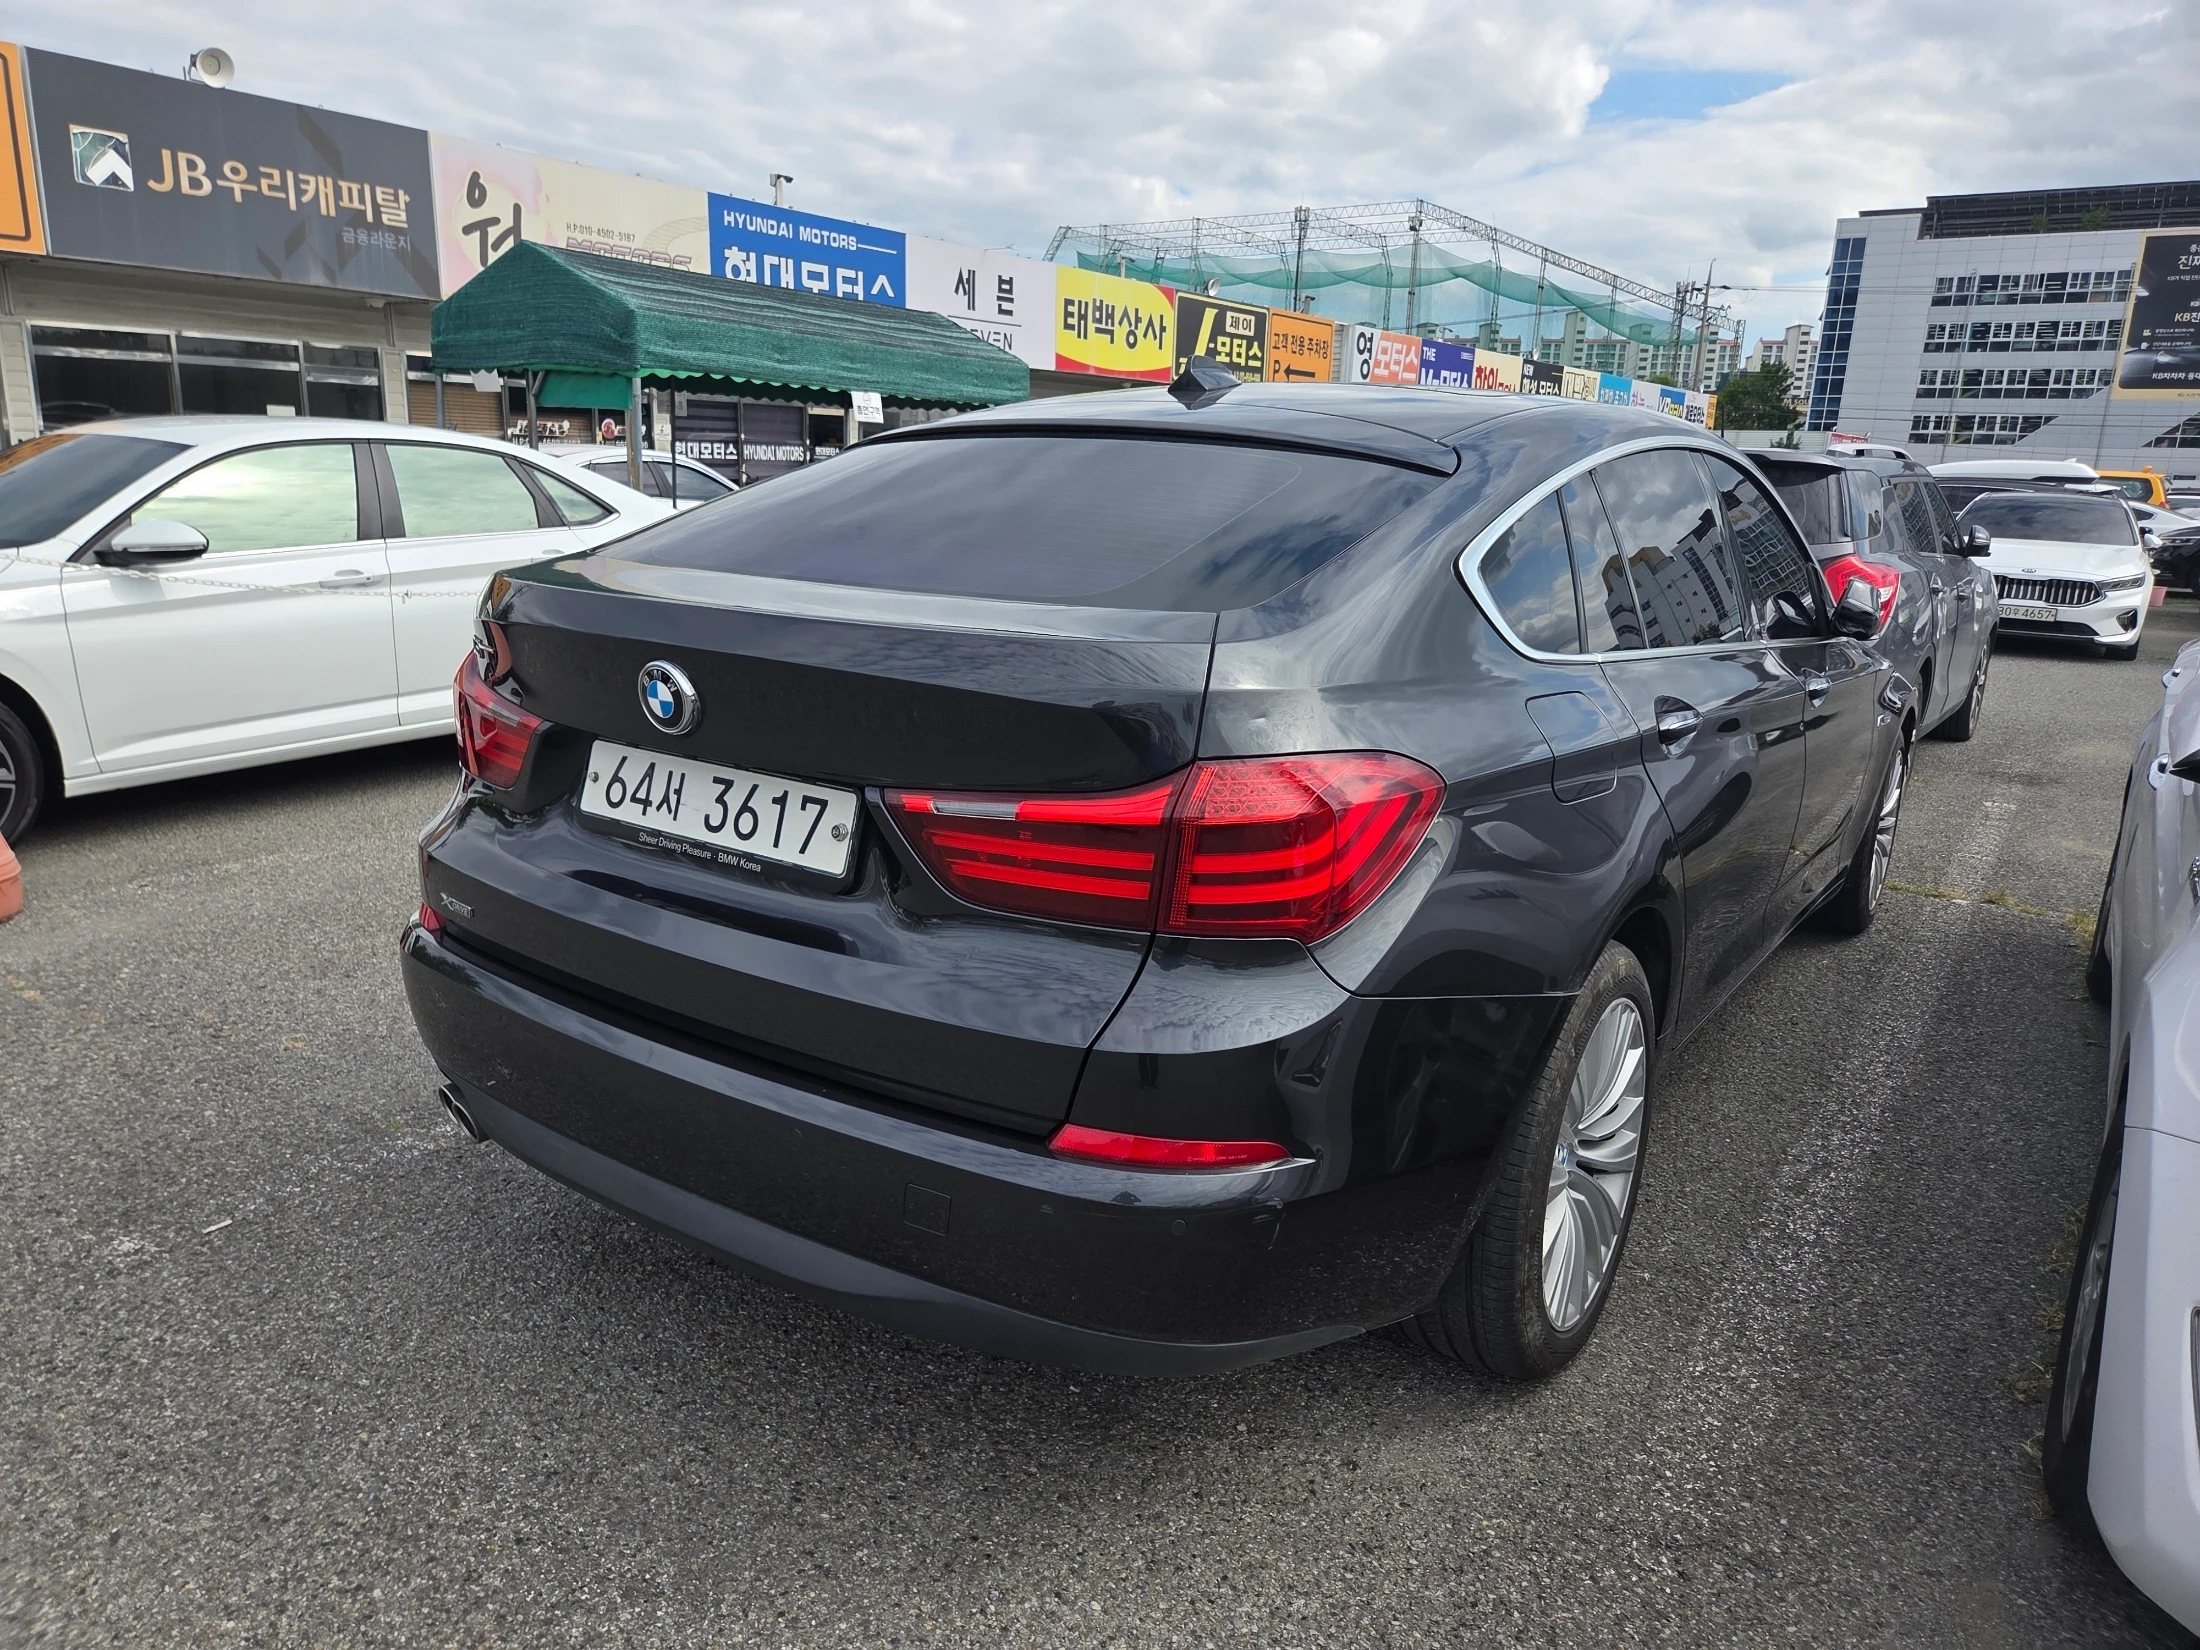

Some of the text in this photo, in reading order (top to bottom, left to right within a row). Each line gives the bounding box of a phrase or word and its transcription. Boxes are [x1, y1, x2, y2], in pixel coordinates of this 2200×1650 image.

[147, 148, 411, 229] JB우리캐피탈
[340, 226, 411, 251] 금융라운지
[723, 210, 857, 251] HYUNDAI MOTORS
[1063, 297, 1167, 351] 태백상사
[1272, 332, 1289, 351] 고객
[1423, 347, 1436, 361] THE
[1523, 363, 1534, 377] NEW
[674, 440, 738, 461] 현대모터스
[743, 443, 804, 462] HYUNDAI MOTORS
[2021, 608, 2052, 620] 4657
[643, 669, 678, 692] BMW
[605, 755, 829, 855] 64서 3617
[638, 832, 762, 873] Sheer Driving Pleasure BMW Korea
